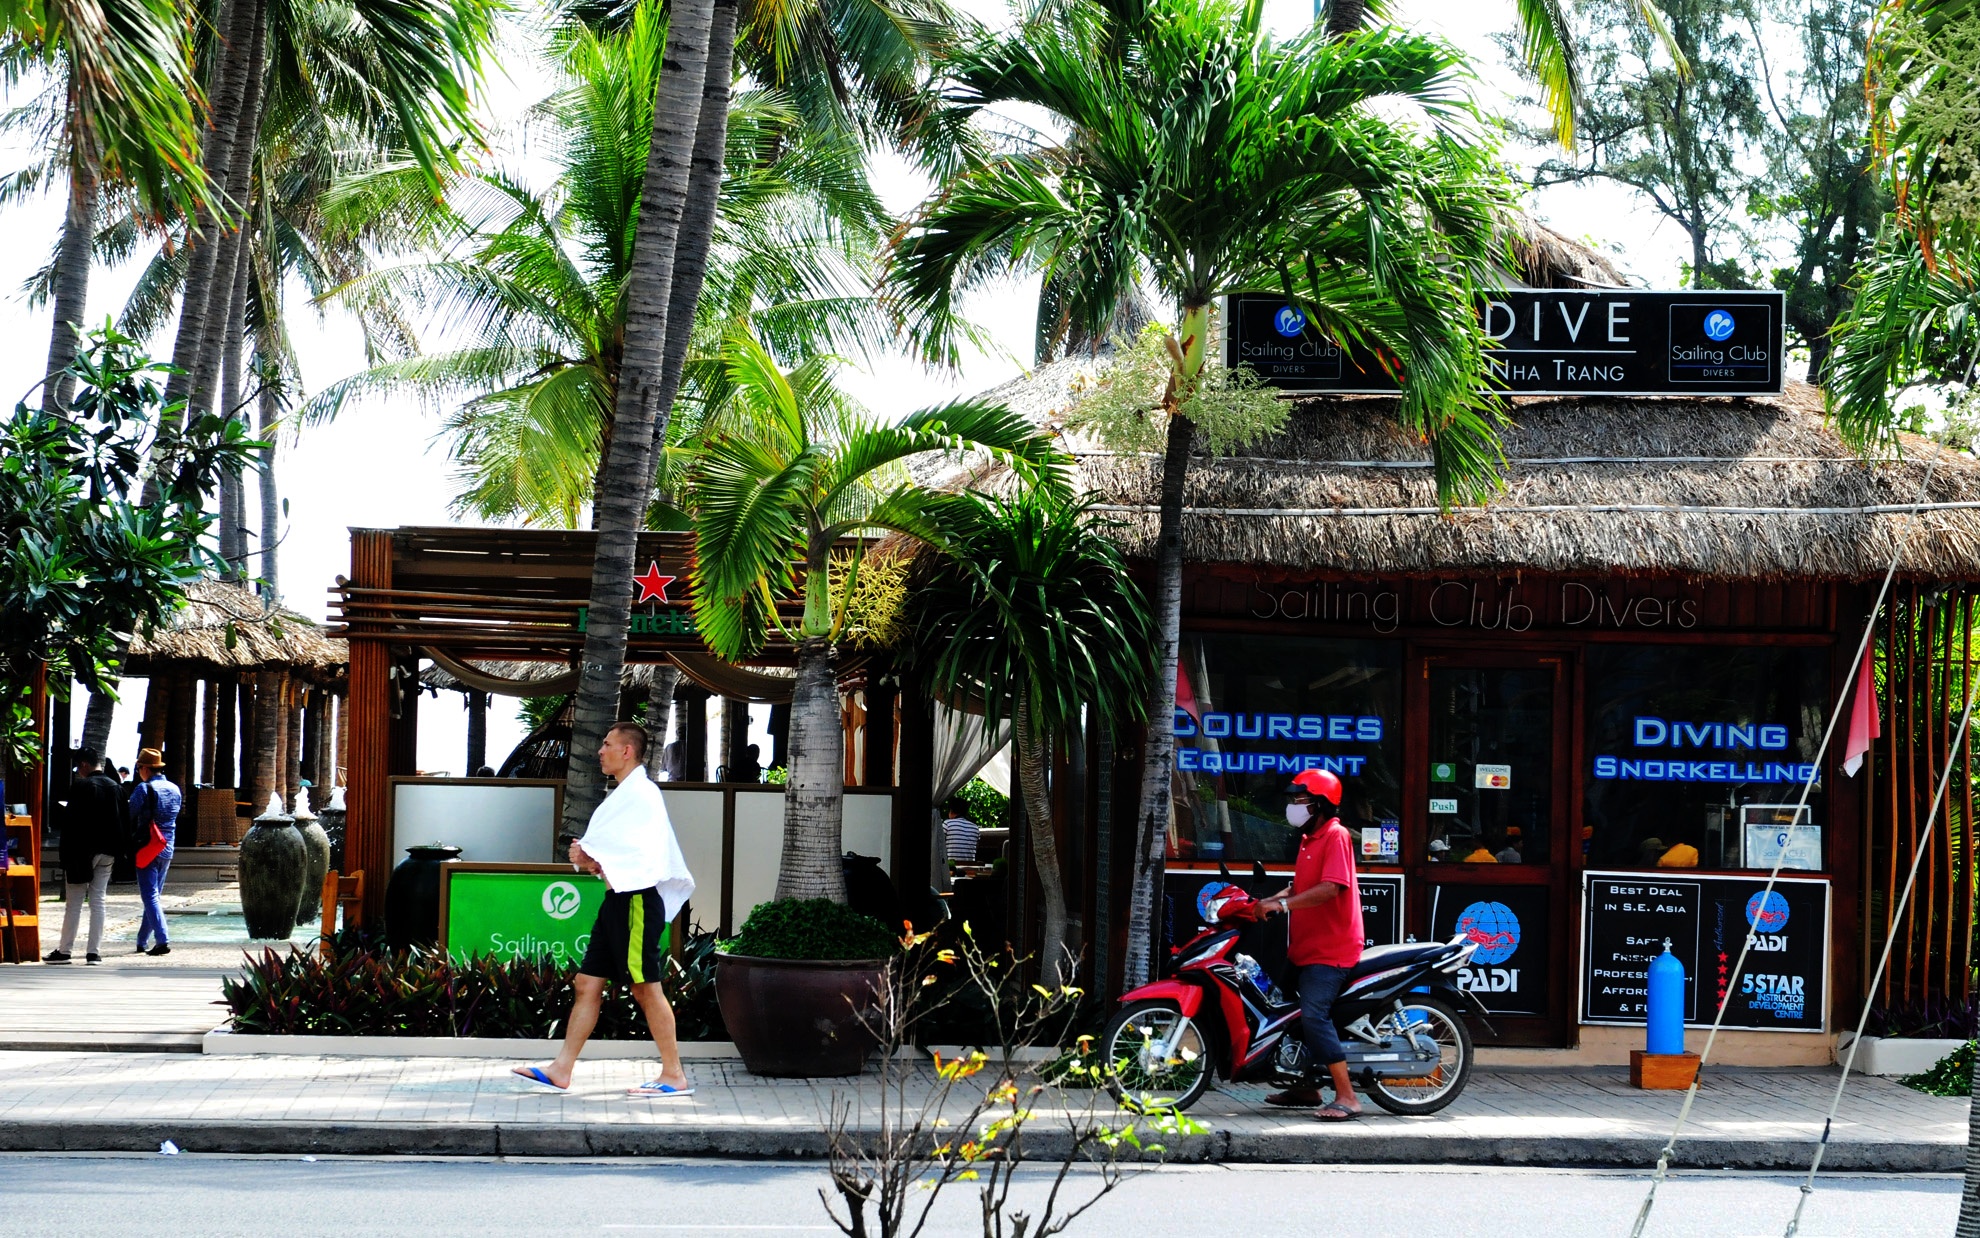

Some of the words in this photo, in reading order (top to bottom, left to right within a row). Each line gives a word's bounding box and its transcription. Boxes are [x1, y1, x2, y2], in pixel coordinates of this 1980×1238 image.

[1485, 301, 1631, 343] DIVE
[1241, 341, 1294, 361] Sailing
[1300, 341, 1338, 357] Club
[1672, 345, 1724, 365] Sailing
[1729, 345, 1767, 361] Club
[1272, 365, 1306, 373] DIVERS
[1489, 359, 1540, 381] NHA
[1552, 359, 1625, 381] TRANG
[1703, 369, 1735, 377] DIVERS
[1251, 581, 1399, 634] Sailing
[1429, 581, 1533, 632] Club
[1562, 582, 1697, 628] Divers
[1173, 709, 1383, 741] COURSES
[1635, 718, 1787, 748] DIVING
[1178, 750, 1365, 774] EQUIPMENT
[1595, 757, 1818, 781] SNORKELLING
[1431, 801, 1455, 811] Push
[1610, 885, 1644, 895] BEST
[1649, 887, 1683, 896] DEAL
[1623, 903, 1651, 912] S.E.
[1655, 904, 1686, 913] ASIA
[491, 933, 565, 959] Sailing
[1626, 936, 1659, 945] SAF
[1746, 934, 1788, 952] PADI
[1457, 969, 1518, 992] PADI
[1619, 1003, 1629, 1012] &
[1748, 1001, 1804, 1011] DEVELOPMENT
[1756, 993, 1805, 1003] INSTRUCTOR
[1774, 1010, 1804, 1019] CENTRE
